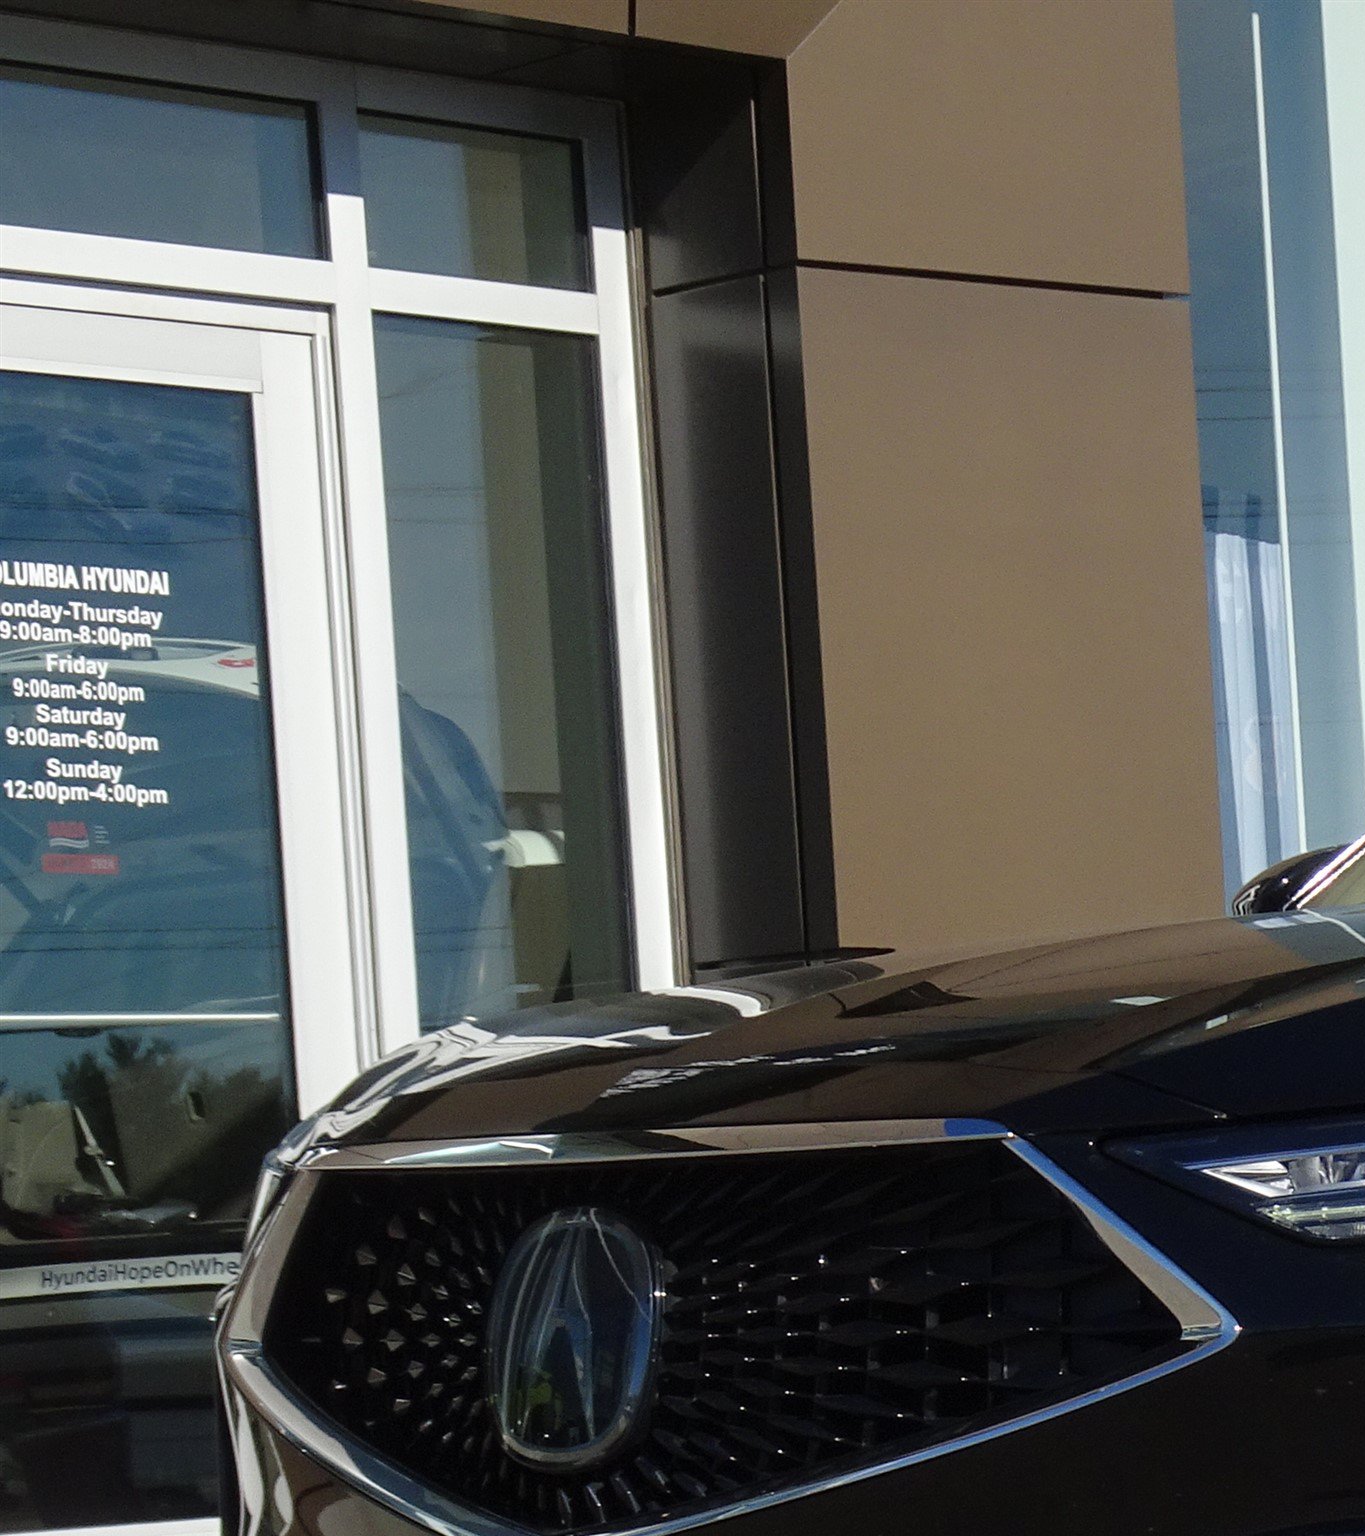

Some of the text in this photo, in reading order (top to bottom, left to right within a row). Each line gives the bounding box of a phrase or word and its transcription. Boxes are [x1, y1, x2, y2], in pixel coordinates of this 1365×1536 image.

[0, 560, 170, 595] LUMBIA HYUNDAI
[0, 599, 163, 630] onday-Thursday
[0, 619, 152, 650] 9:00am-8:00pm
[45, 653, 108, 679] Friday
[12, 677, 145, 705] 9:00am-6:00pm
[36, 704, 126, 730] Saturday
[5, 726, 159, 754] 9:00am-6:00pm
[46, 757, 123, 784] Sunday
[3, 779, 169, 807] 12:00pm-4:00pm
[41, 1257, 241, 1291] HyundaiHopeOnWhe
